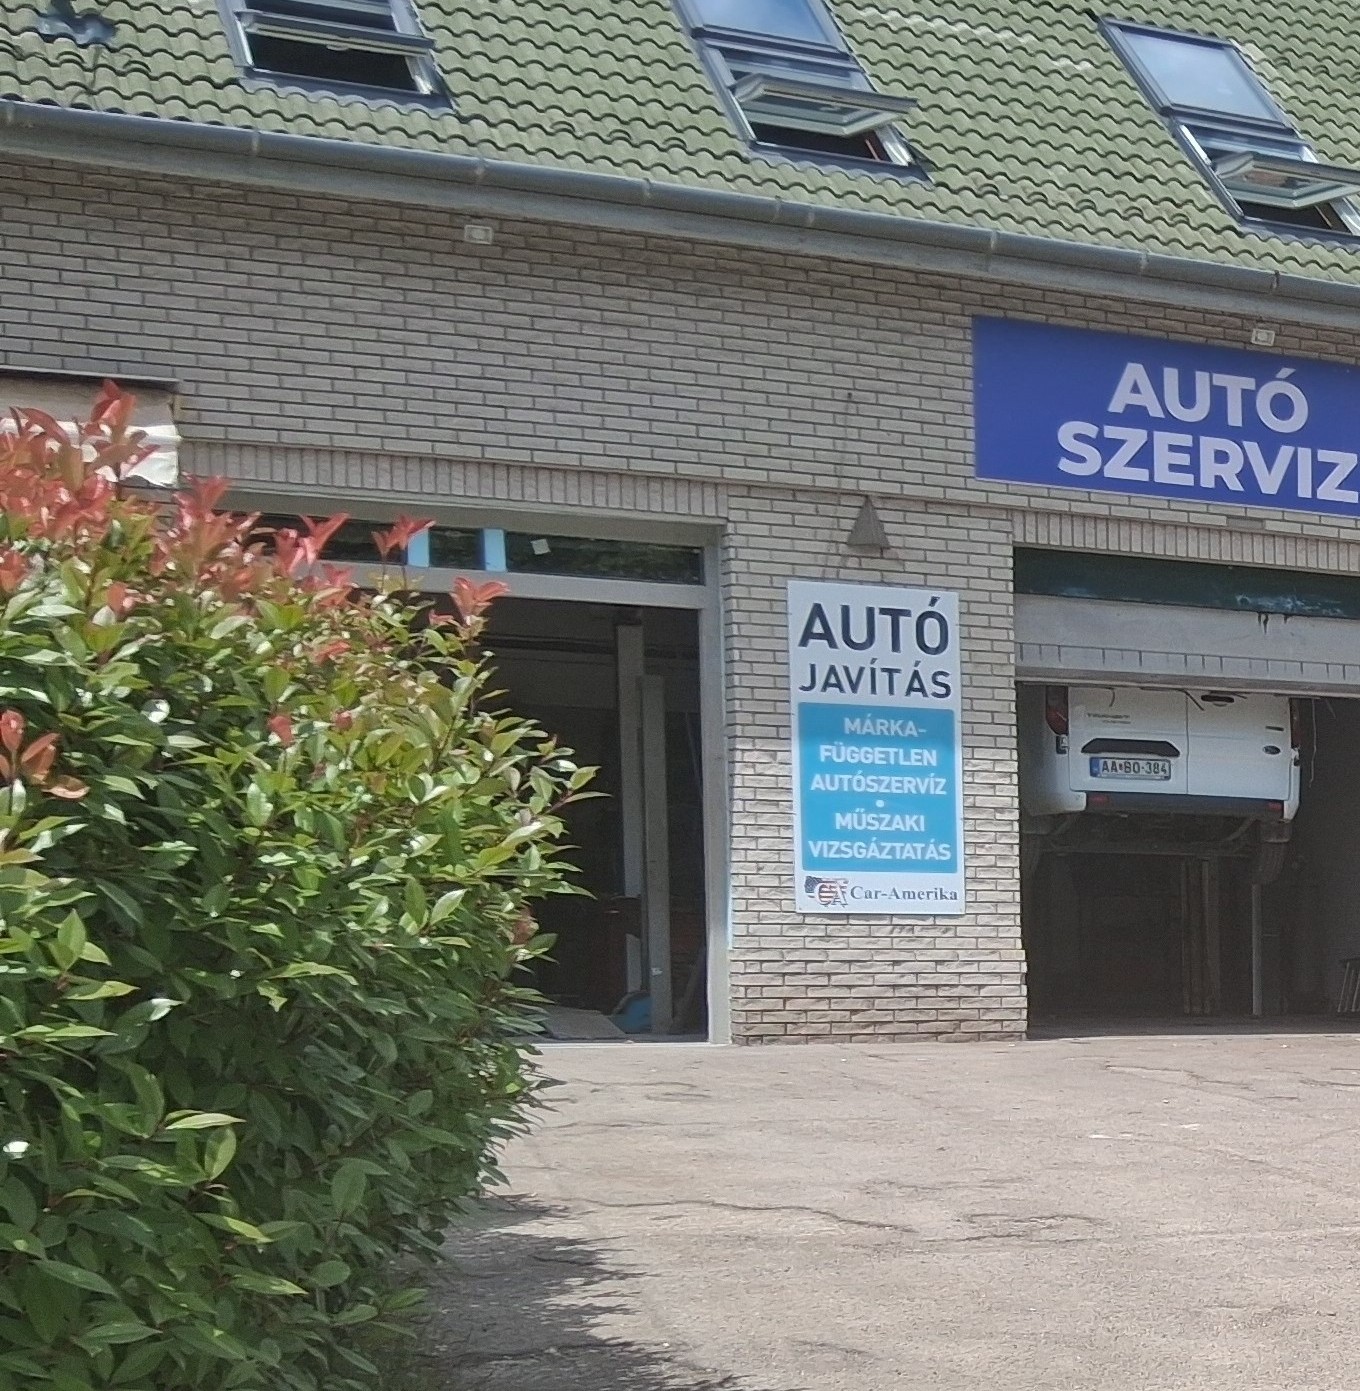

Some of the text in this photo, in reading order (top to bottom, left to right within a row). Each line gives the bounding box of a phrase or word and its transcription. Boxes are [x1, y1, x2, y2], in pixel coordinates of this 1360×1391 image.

[1107, 362, 1308, 434] AUTÓ
[1057, 420, 1359, 504] SZERVIZ
[798, 596, 949, 656] AUTÓ
[798, 657, 952, 699] JAVÍTÁS
[843, 713, 927, 738] MÁRKA-
[819, 744, 938, 767] FÜGGETLEN
[810, 770, 948, 796] AUTÓSZERVÍZ
[834, 808, 926, 833] MŰSZAKI
[808, 837, 952, 861] VIZSGÁZTATÁS
[850, 886, 958, 902] Car-Amerika
